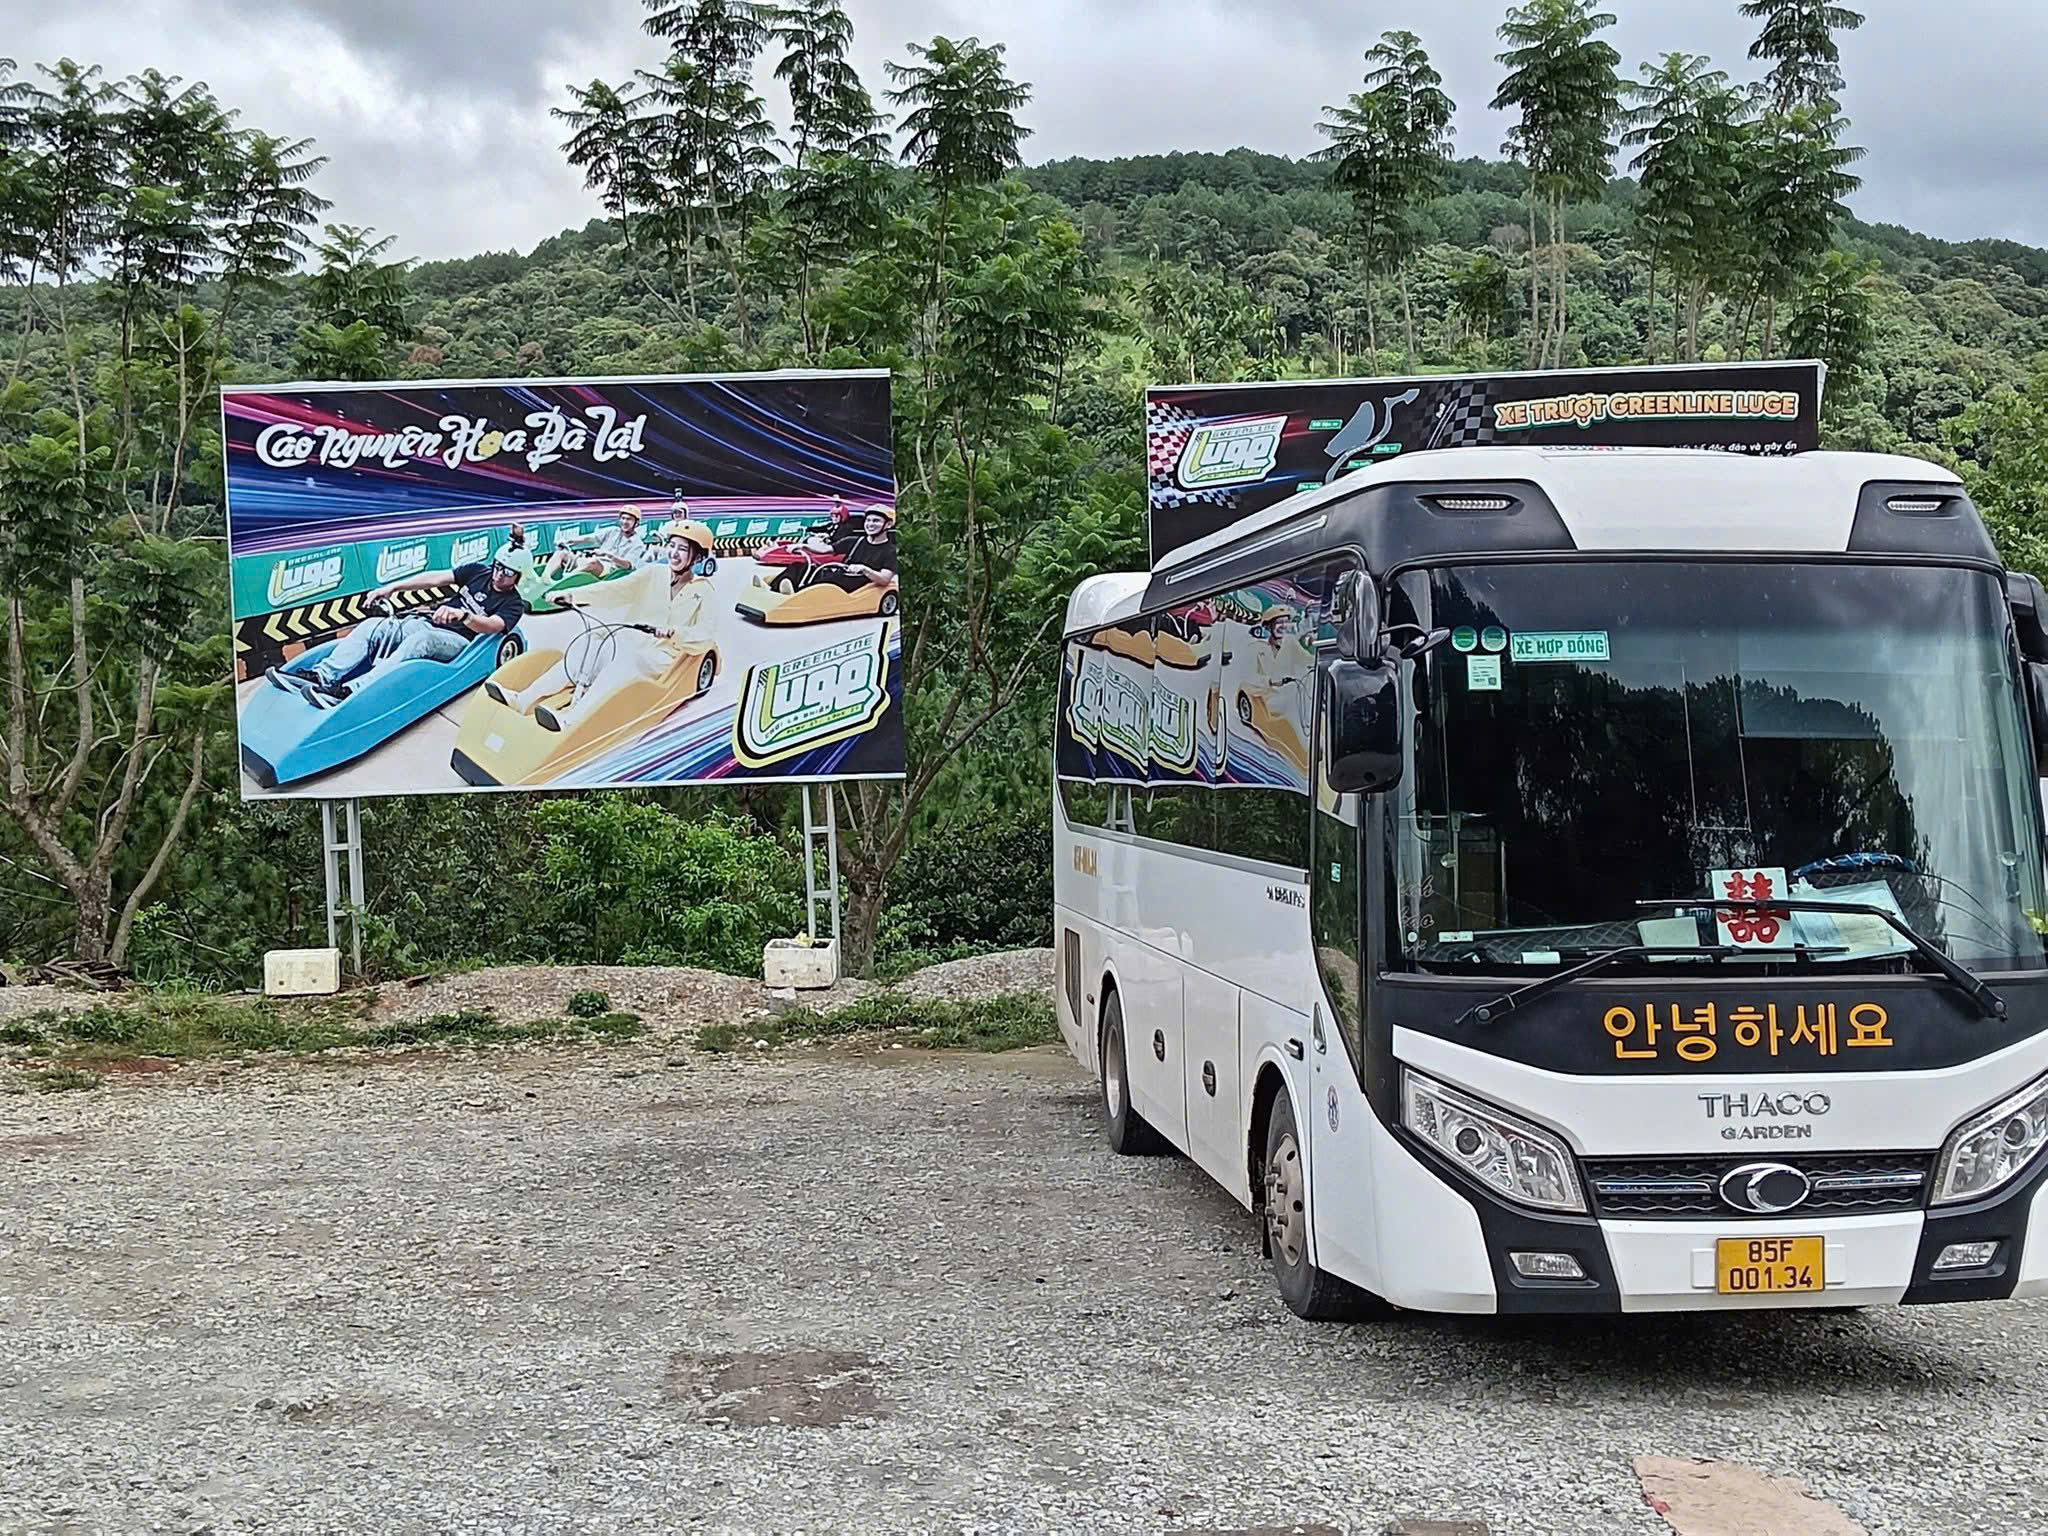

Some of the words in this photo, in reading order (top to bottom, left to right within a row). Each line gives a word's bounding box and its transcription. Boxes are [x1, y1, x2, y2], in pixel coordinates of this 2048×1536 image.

[1499, 404, 1528, 426] XE
[1531, 396, 1606, 423] TRƯỢT
[1611, 393, 1733, 416] GREENLINE
[1737, 393, 1797, 415] LUGE
[256, 423, 316, 467] Cao
[314, 425, 443, 468] Nguyên
[439, 415, 527, 469] Hoa
[525, 406, 588, 472] Đà
[585, 405, 647, 463] Lạt
[1190, 430, 1272, 474] Luge
[274, 555, 344, 599] Luge
[782, 637, 873, 675] GREENLINE
[1516, 640, 1533, 655] XE
[1537, 639, 1563, 656] HỢP
[760, 652, 875, 733] Luge
[1603, 1001, 1894, 1062] 안녕하세요
[1698, 1090, 1831, 1118] THACO
[1721, 1124, 1812, 1140] GARDEN
[1748, 1240, 1793, 1263] 85F
[1729, 1265, 1813, 1291] 001.34
